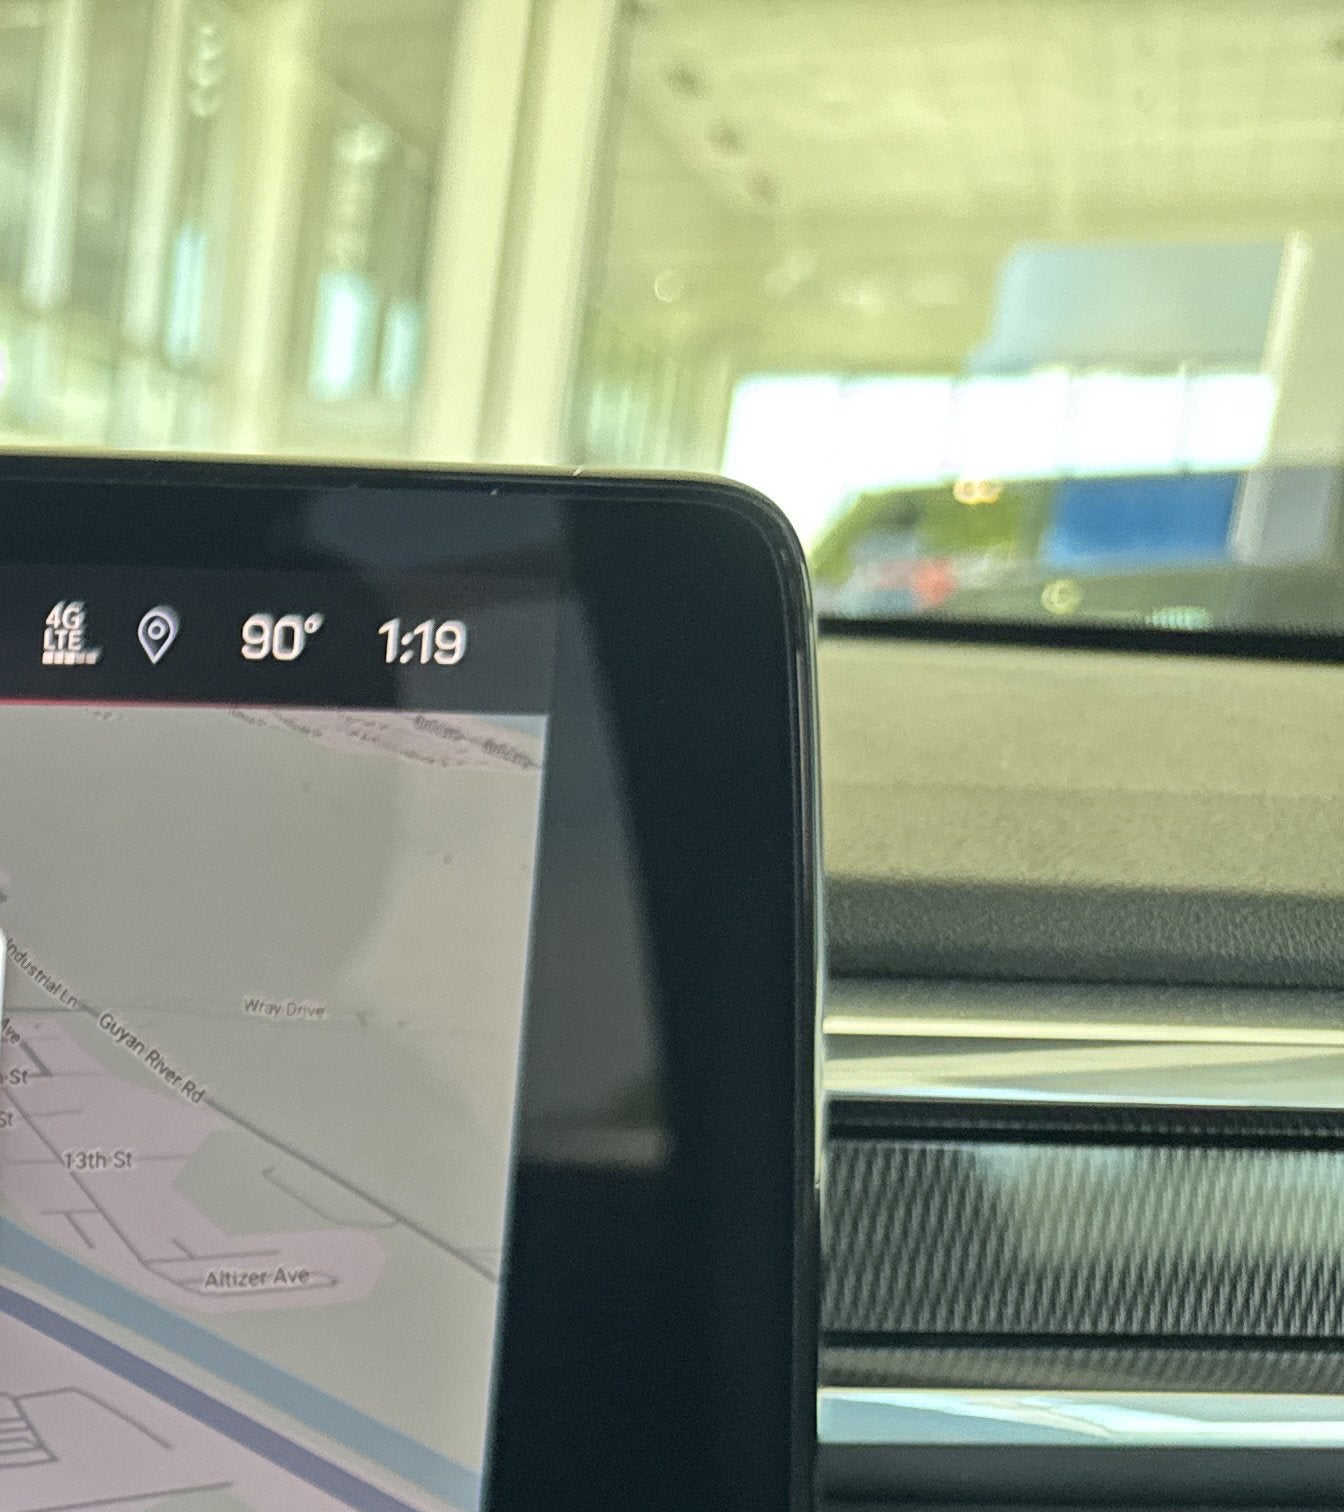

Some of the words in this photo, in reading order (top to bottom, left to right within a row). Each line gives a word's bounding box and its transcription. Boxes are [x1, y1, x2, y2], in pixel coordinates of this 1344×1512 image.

[45, 601, 85, 629] 4G
[43, 629, 83, 651] LTE
[241, 612, 324, 661] 90°
[378, 617, 467, 665] 1:19
[5, 937, 63, 1002] Industrial
[59, 987, 79, 1008] Ln
[99, 1012, 145, 1056] Guyan
[144, 1048, 182, 1087] River
[180, 1079, 206, 1105] Rd
[63, 1152, 107, 1170] 13th
[113, 1149, 133, 1168] St
[204, 1269, 269, 1290] Altizer
[273, 1266, 311, 1286] Ave
